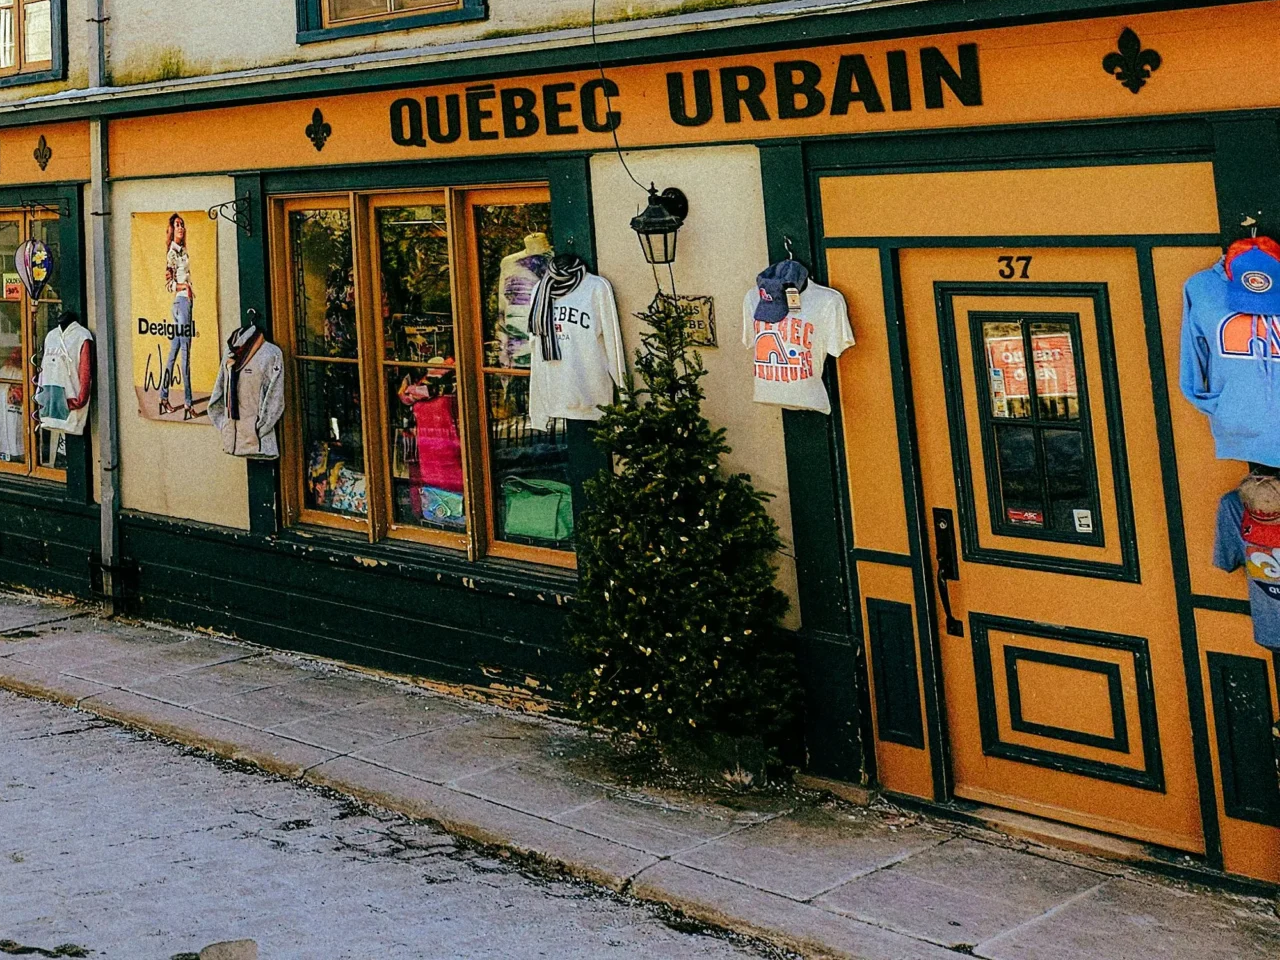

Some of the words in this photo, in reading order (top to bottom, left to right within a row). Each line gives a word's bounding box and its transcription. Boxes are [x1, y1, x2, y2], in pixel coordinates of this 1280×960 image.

[666, 42, 984, 128] URBAIN
[997, 255, 1033, 280] 37
[138, 317, 196, 341] Desigual
[1001, 347, 1063, 364] OUERT
[144, 343, 182, 393] Wow
[1013, 365, 1059, 382] OEN
